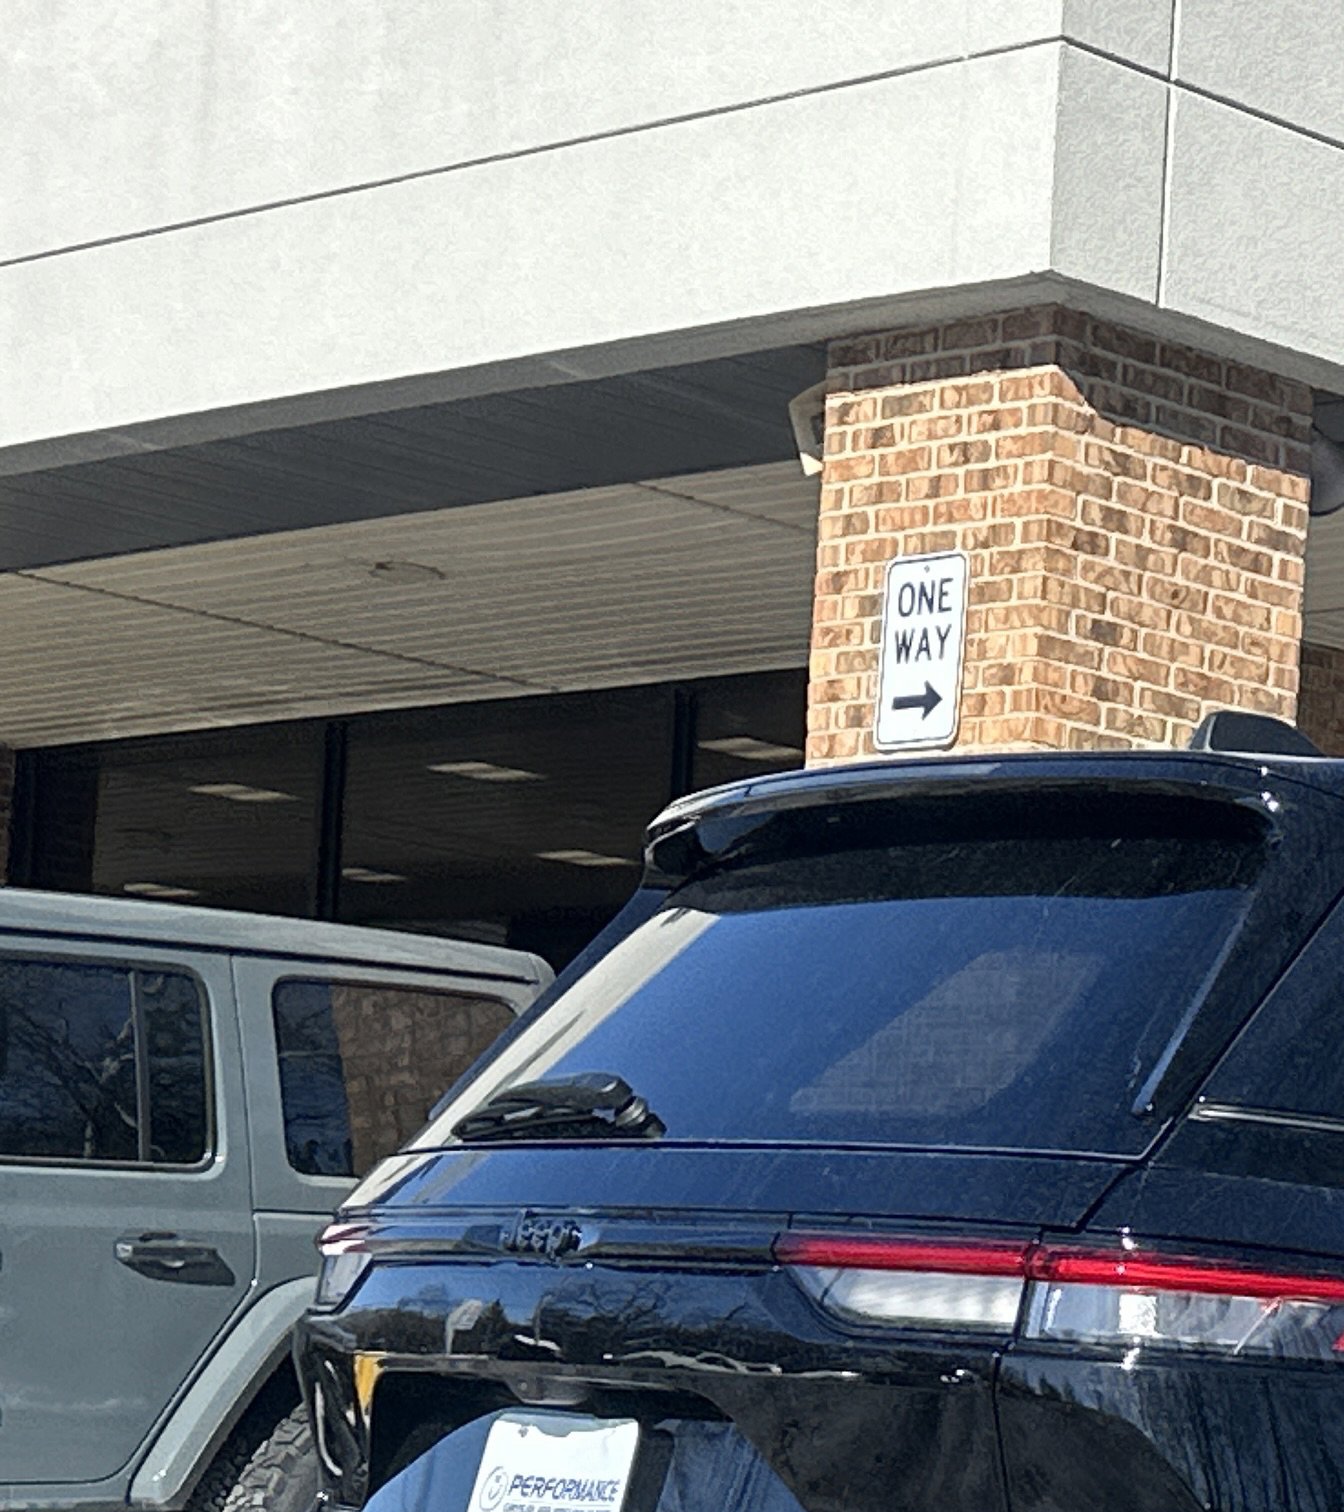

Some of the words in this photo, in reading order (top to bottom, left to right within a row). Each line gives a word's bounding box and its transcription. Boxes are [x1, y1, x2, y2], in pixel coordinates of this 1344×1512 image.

[898, 577, 954, 617] ONE
[894, 623, 953, 665] WAY
[501, 1208, 582, 1258] Jeep
[508, 1474, 621, 1502] PERFORMANCE
